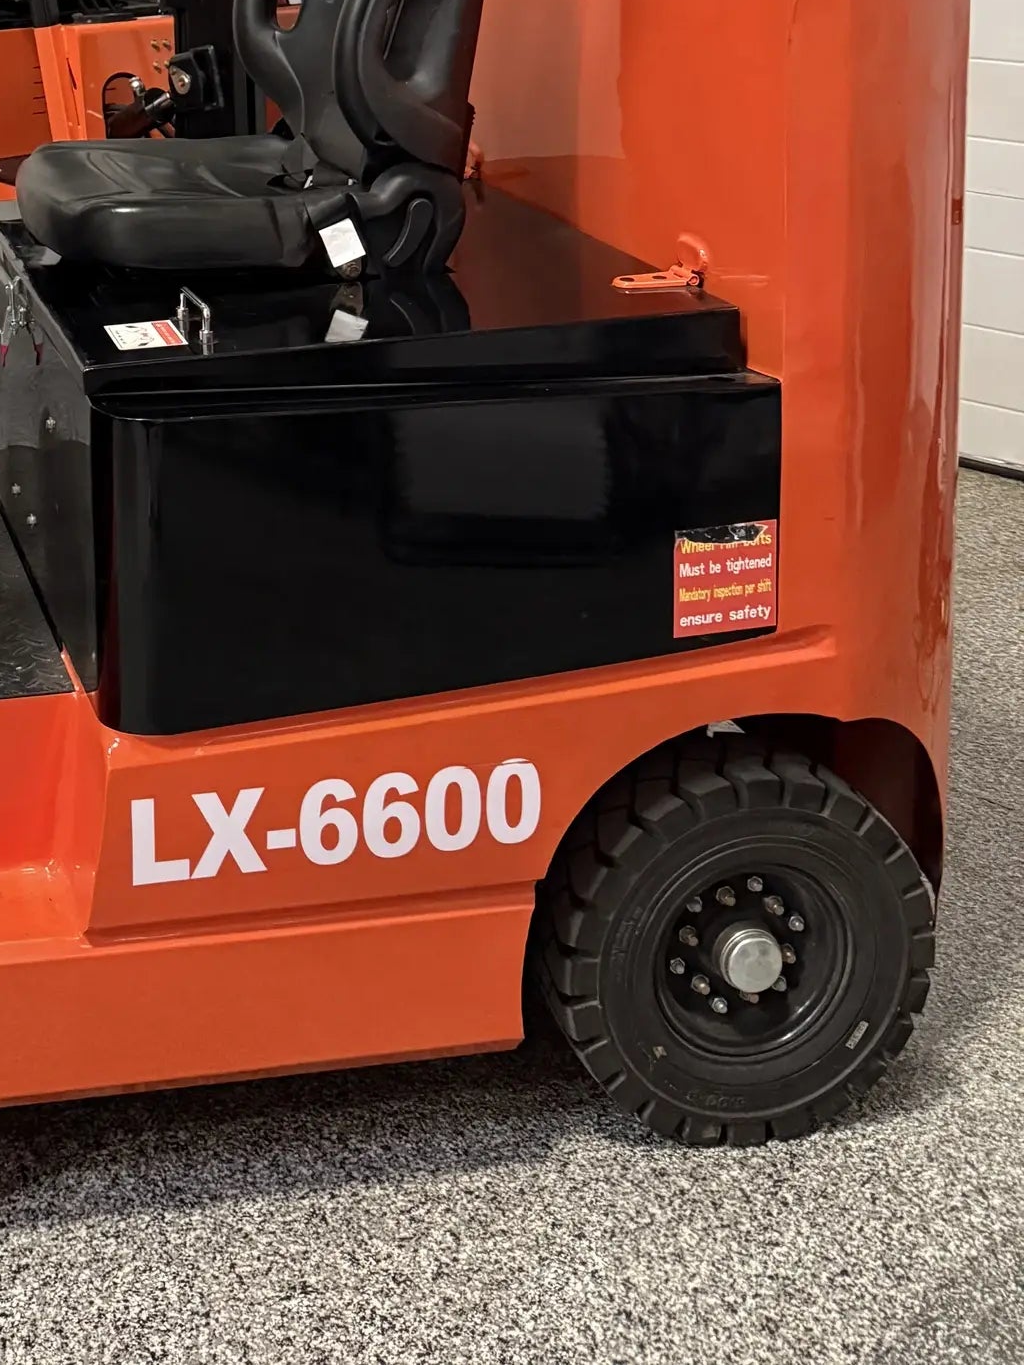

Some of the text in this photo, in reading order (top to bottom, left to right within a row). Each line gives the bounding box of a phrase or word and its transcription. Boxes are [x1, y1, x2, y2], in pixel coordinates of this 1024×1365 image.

[679, 553, 772, 578] Must be tightened
[679, 578, 772, 602] Mandatory inspection per shift
[679, 604, 772, 627] ensure safety
[130, 757, 542, 887] LX-6600
